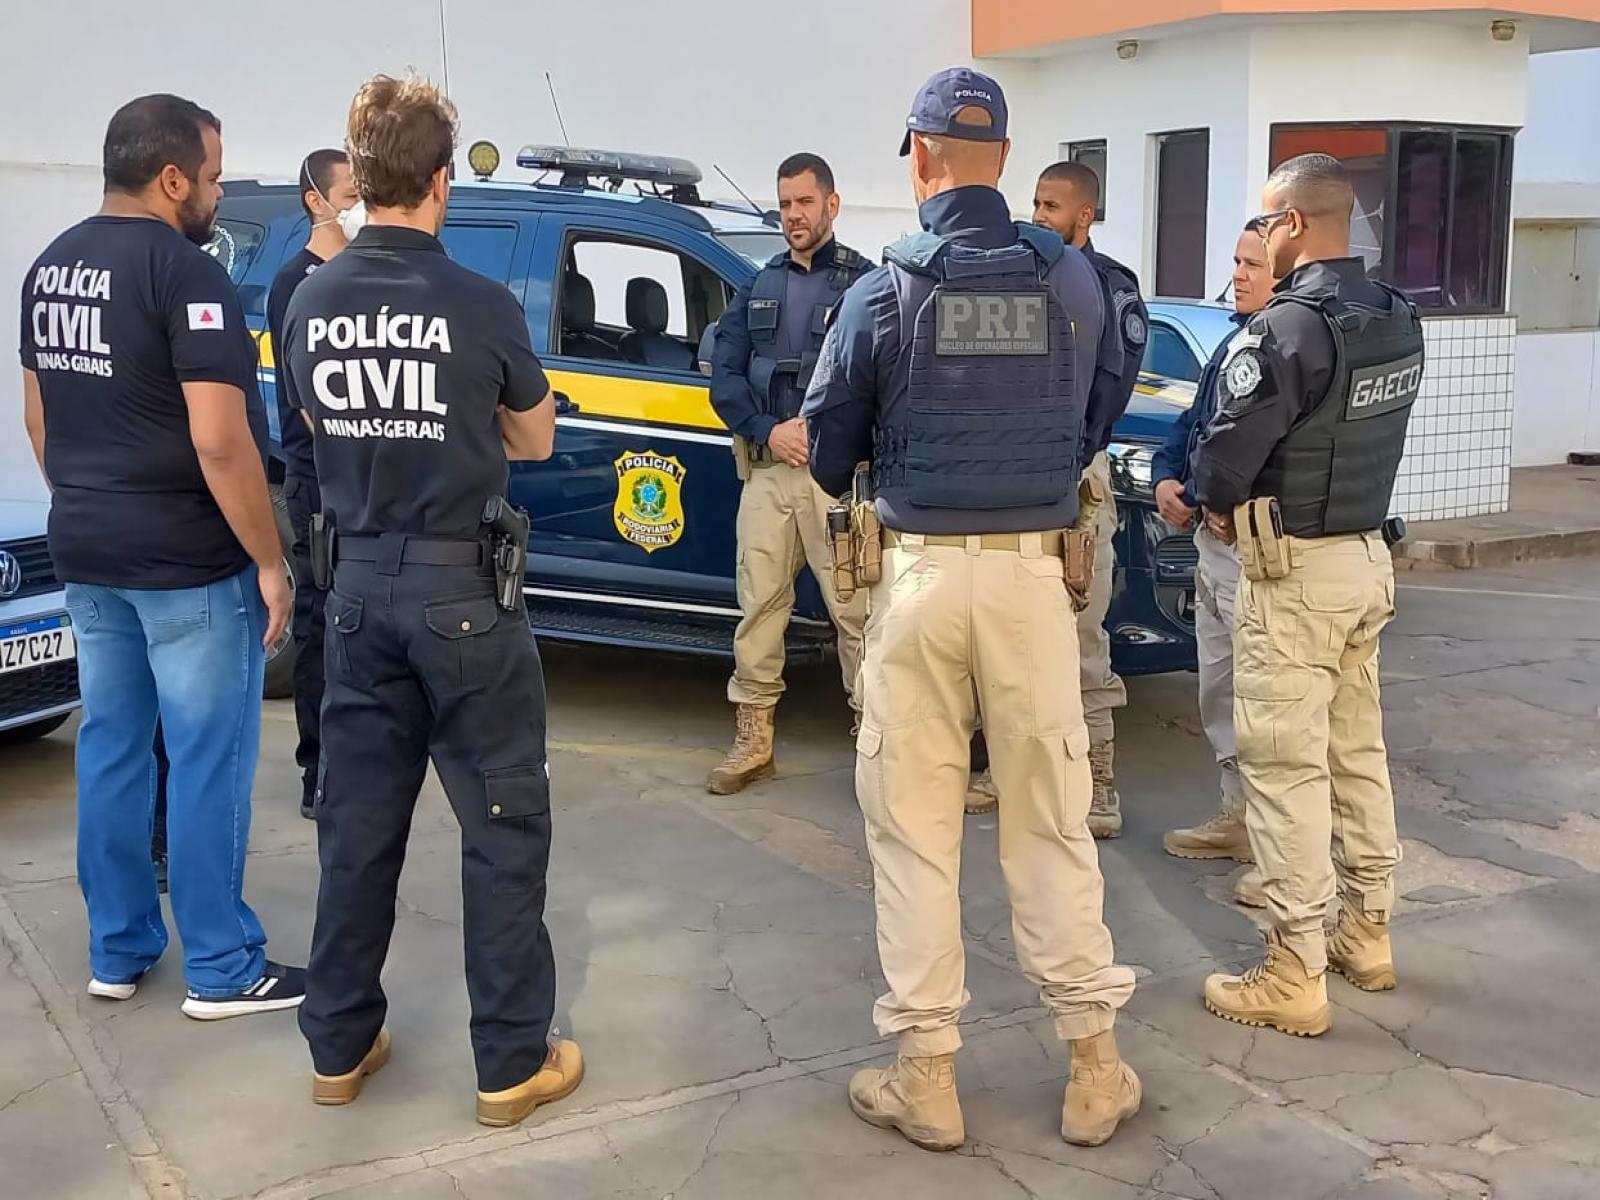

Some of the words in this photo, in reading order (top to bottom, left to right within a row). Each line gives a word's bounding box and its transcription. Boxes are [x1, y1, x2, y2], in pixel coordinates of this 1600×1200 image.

[32, 260, 111, 301] POLÍCIA
[32, 301, 111, 355] CIVIL
[307, 305, 452, 353] POLÍCIA
[940, 295, 1042, 339] PRF
[35, 353, 70, 371] MINAS
[71, 355, 113, 377] GERAIS
[1351, 363, 1421, 408] GAECO
[312, 358, 448, 416] CIVIL
[322, 418, 383, 438] MINAS
[384, 420, 445, 442] GERAIS
[624, 456, 674, 475] POLICIA
[630, 531, 669, 545] FEDERAL
[0, 631, 63, 669] Z7C27
